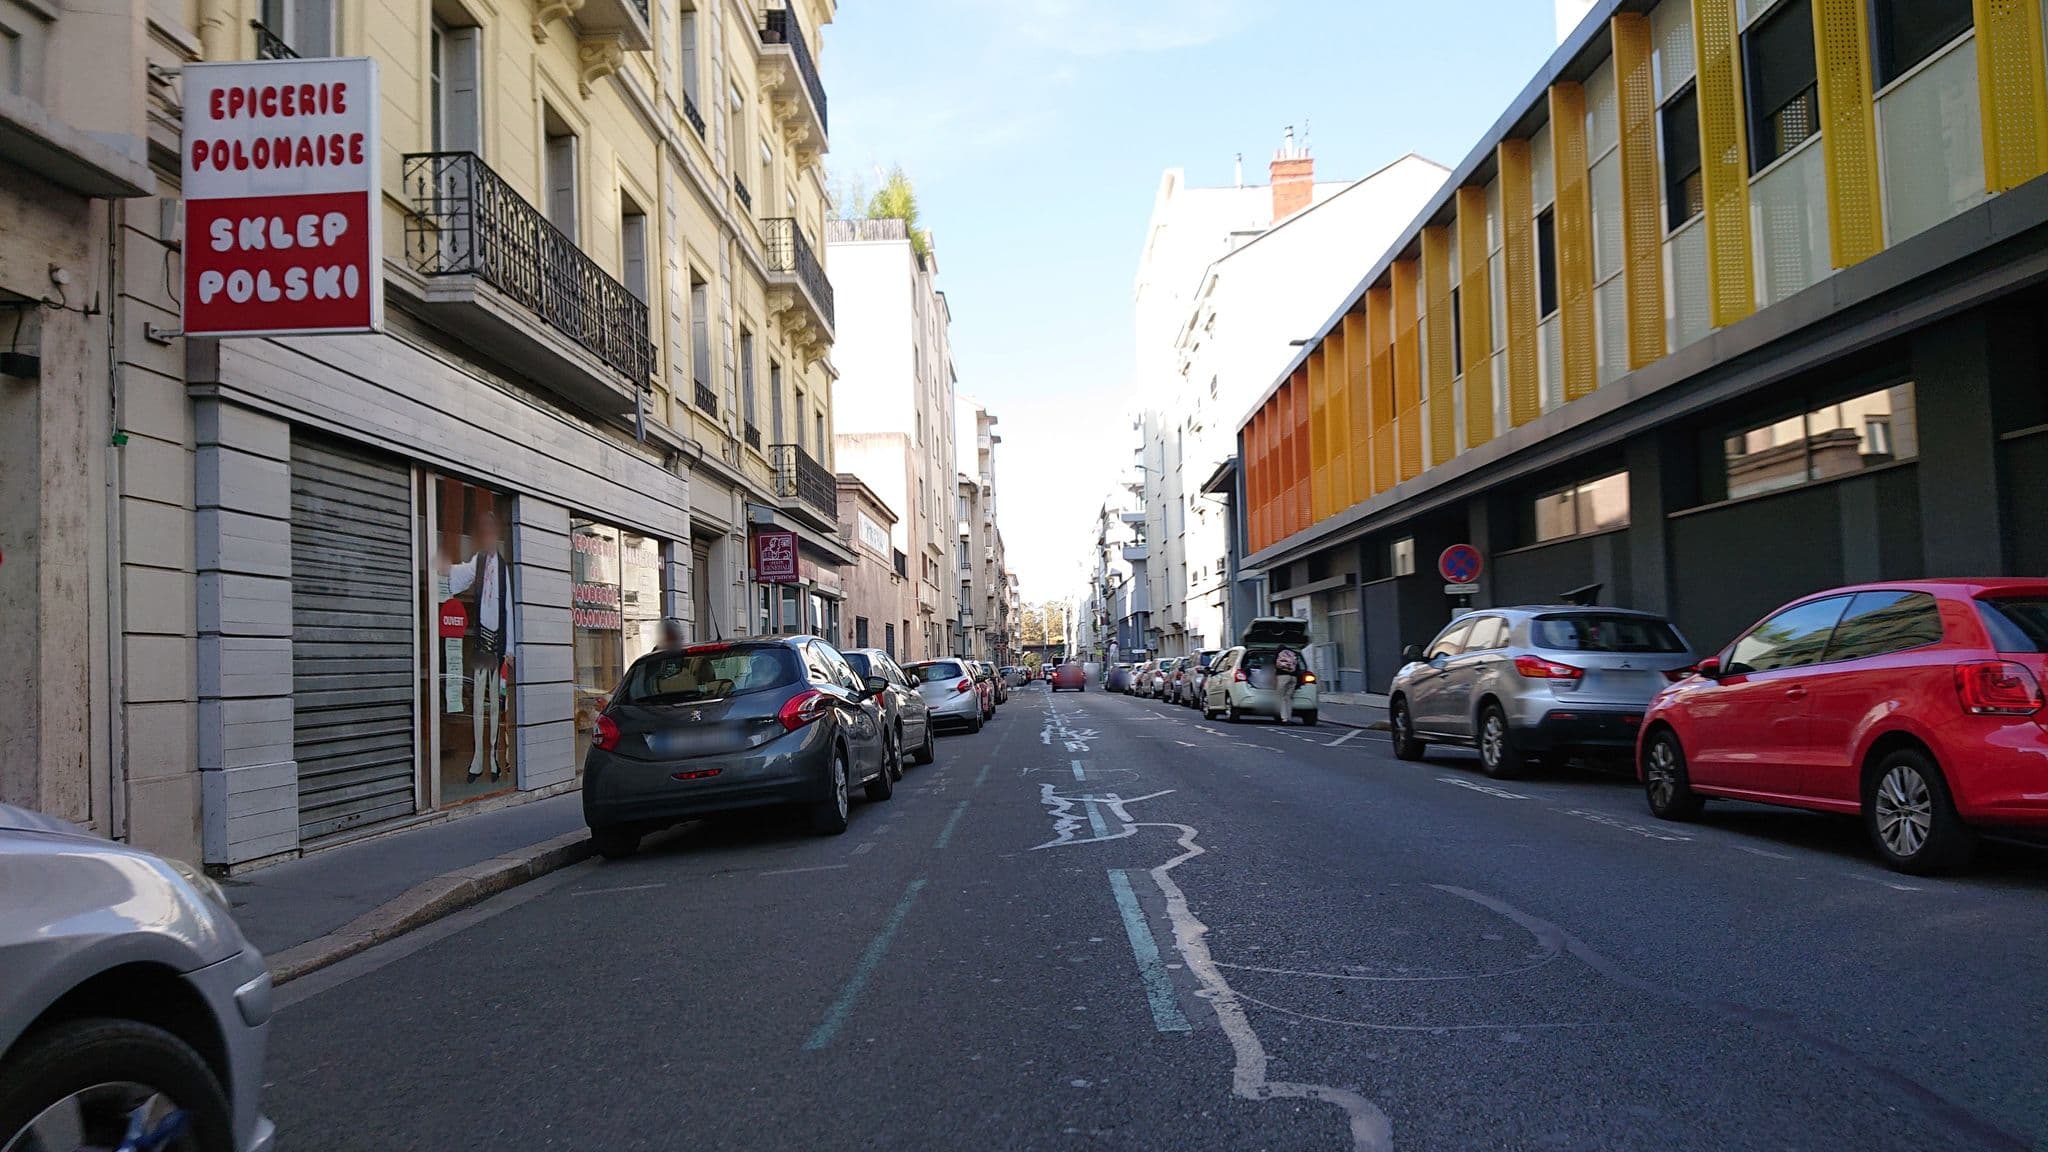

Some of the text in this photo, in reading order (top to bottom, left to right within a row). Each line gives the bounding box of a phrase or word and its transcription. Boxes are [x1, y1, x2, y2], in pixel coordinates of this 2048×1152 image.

[210, 83, 346, 120] EPICERIE
[192, 133, 364, 171] POLONAISE
[209, 212, 348, 251] SKLEP
[198, 263, 360, 304] POLSKI
[570, 582, 618, 606] 'AUBERGE
[443, 616, 465, 626] OUVERT
